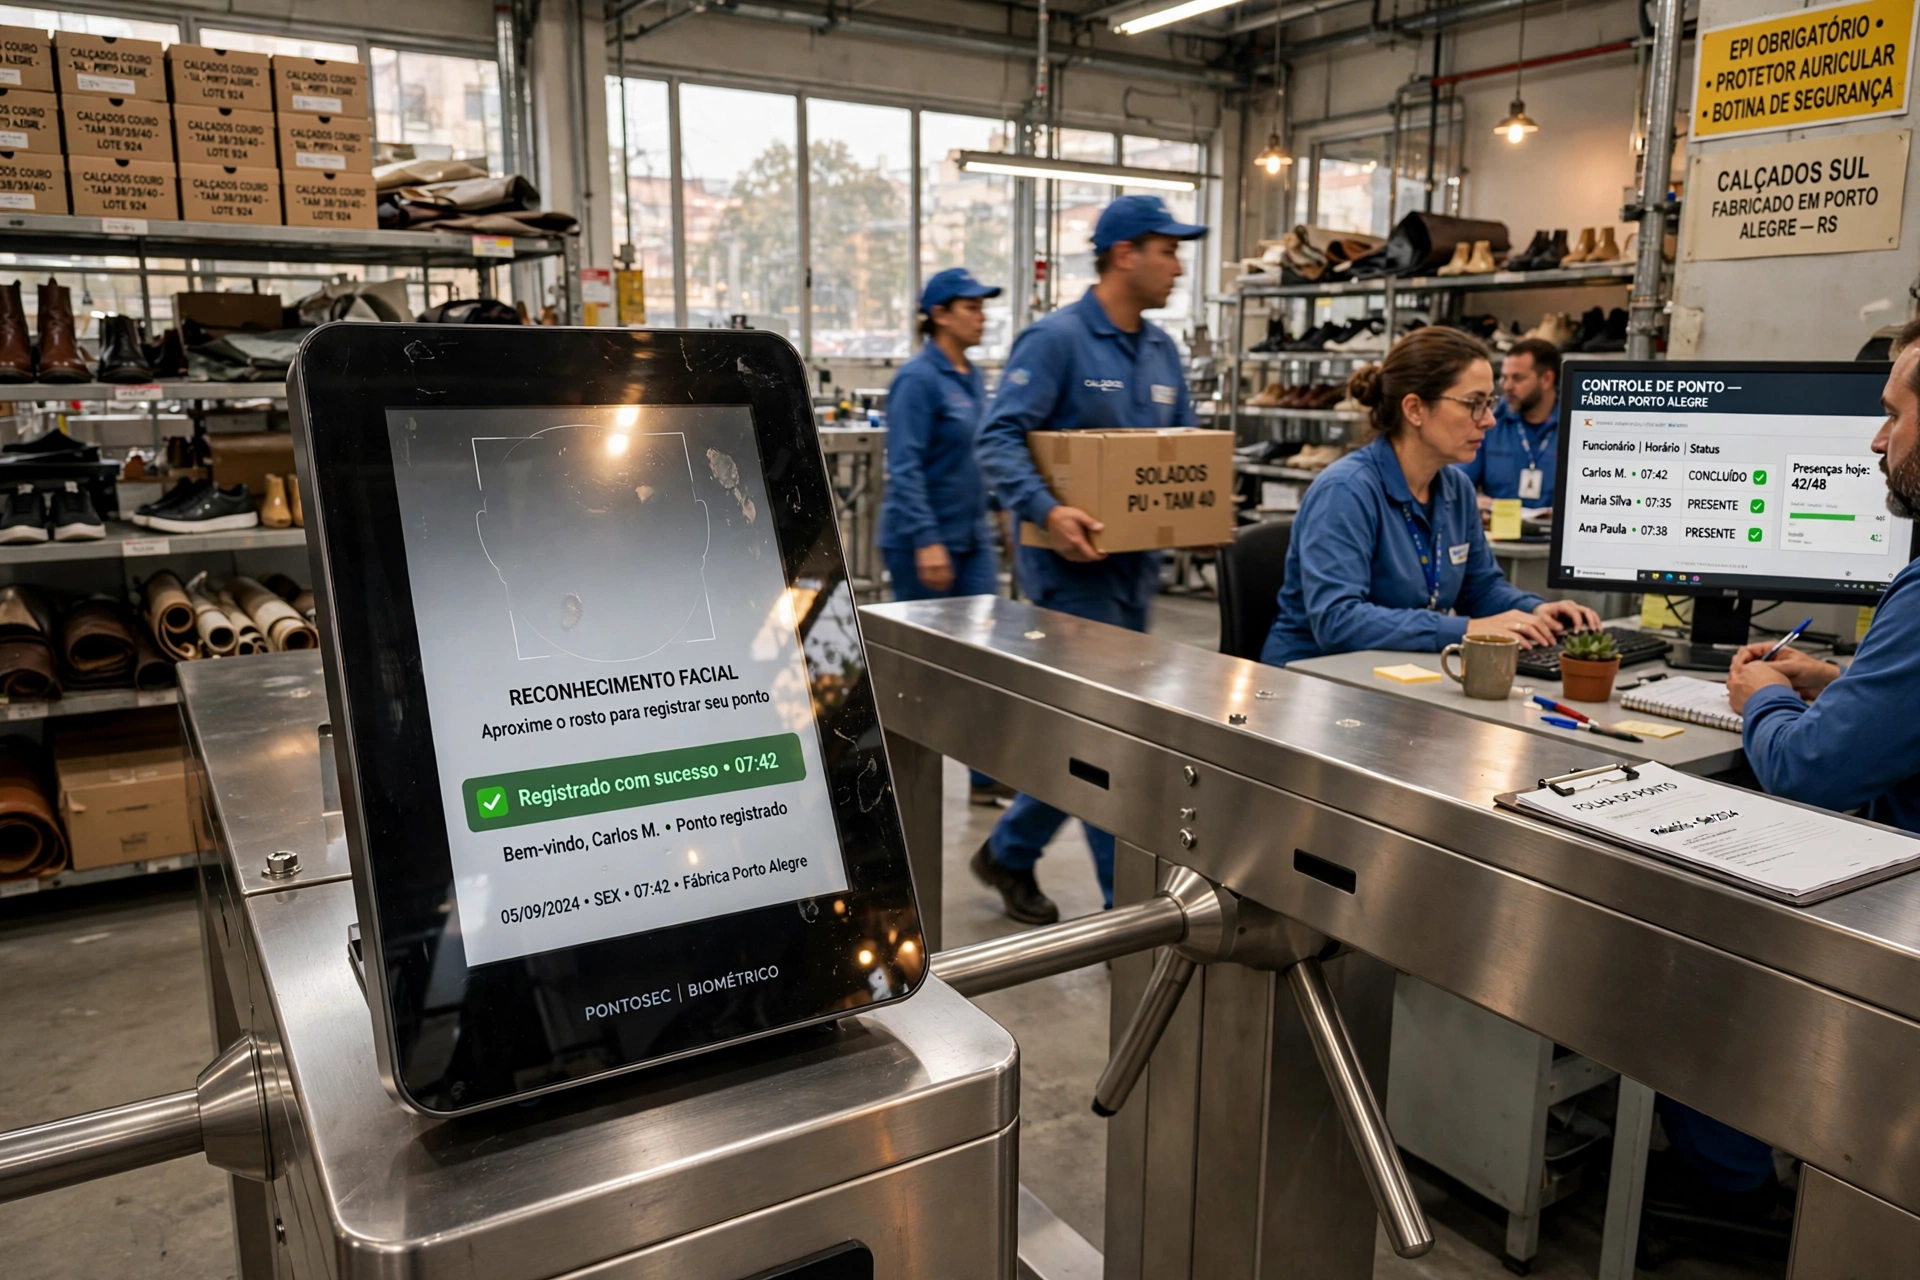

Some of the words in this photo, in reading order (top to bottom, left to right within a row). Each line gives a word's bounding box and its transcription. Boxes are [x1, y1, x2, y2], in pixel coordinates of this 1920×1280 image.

[1729, 37, 1753, 61] EPI
[1757, 15, 1870, 56] OBRIGATÓRIO
[4, 41, 38, 54] COURO
[70, 48, 118, 62] CALÇADOS
[121, 51, 152, 65] COURO
[184, 60, 229, 73] CALÇADOS
[231, 64, 259, 76] COURO
[1715, 60, 1796, 93] PROTETOR
[1799, 44, 1895, 80] AURICULAR
[286, 70, 328, 83] CALÇADOS
[330, 74, 357, 86] COURO
[202, 88, 225, 99] LOTE
[227, 89, 244, 100] 924
[1712, 95, 1765, 123] BOTINA
[1770, 92, 1789, 114] DE
[1793, 76, 1894, 112] SEGURANÇA
[12, 106, 45, 118] COURO
[77, 111, 126, 124] CALÇADOS
[128, 114, 158, 127] COURO
[84, 124, 106, 134] TAM
[188, 120, 233, 134] CALÇADOS
[235, 124, 264, 136] COURO
[291, 128, 332, 141] CALÇADOS
[334, 131, 361, 143] COURO
[98, 139, 122, 151] LOTE
[124, 141, 142, 152] 924
[196, 134, 215, 144] TAM
[206, 147, 229, 158] LOTE
[232, 148, 248, 160] 924
[20, 168, 52, 180] COURO
[83, 172, 132, 185] CALÇADOS
[134, 174, 164, 186] COURO
[1717, 161, 1822, 194] CALÇADOS
[1829, 156, 1870, 182] SUL
[90, 185, 112, 195] TAM
[193, 178, 238, 192] CALÇADOS
[240, 182, 269, 193] COURO
[296, 184, 337, 198] CALÇADOS
[339, 187, 366, 198] COURO
[200, 192, 220, 202] TAM
[302, 197, 321, 207] TAM
[1712, 194, 1794, 218] FABRICADO
[1798, 192, 1820, 210] EM
[1824, 186, 1879, 209] PORTO
[103, 200, 126, 210] LOTE
[130, 201, 147, 211] 924
[212, 206, 234, 216] LOTE
[237, 206, 252, 216] 924
[312, 211, 334, 221] LOTE
[336, 212, 352, 222] 924
[1739, 218, 1797, 240] ALEGRE
[1817, 215, 1838, 234] RS
[1582, 379, 1653, 392] CONTROLE
[1656, 380, 1674, 393] DE
[1677, 381, 1724, 393] PONTO
[1581, 392, 1626, 406] FÁBRICA
[1628, 396, 1665, 407] PORTO
[1667, 396, 1708, 408] ALEGRE
[1582, 440, 1636, 452] Funcionário
[1644, 441, 1680, 453] Horário
[1690, 444, 1720, 454] Status
[1135, 464, 1208, 486] SOLADOS
[1582, 466, 1612, 479] Carlos
[1614, 468, 1627, 479] M.
[1640, 469, 1668, 480] 07:42
[1688, 467, 1748, 483] CONCLUÍDO
[1792, 463, 1842, 476] Presenças
[1845, 464, 1870, 478] hoje:
[1791, 478, 1827, 490] 42/48
[1127, 494, 1149, 512] PU
[1164, 491, 1195, 511] TAM
[1198, 490, 1216, 508] 40
[1580, 494, 1606, 507] Maria
[1608, 494, 1632, 508] Silva
[1645, 497, 1672, 508] 07:35
[1688, 498, 1738, 511] PRESENTE
[1578, 523, 1598, 534] Ana
[1600, 523, 1627, 536] Paula
[1640, 525, 1668, 537] 07:38
[1686, 526, 1736, 540] PRESENTE
[509, 671, 676, 706] RECONHECIMENTO
[678, 664, 740, 686] FACIAL
[481, 714, 553, 742] Aproxime
[556, 715, 566, 729] o
[569, 709, 606, 727] rosto
[609, 706, 641, 726] para
[643, 696, 701, 721] registrar
[704, 694, 729, 712] seu
[731, 688, 770, 711] ponto
[518, 777, 611, 808] Registrado
[614, 771, 651, 792] com
[654, 762, 719, 787] sucesso
[734, 751, 778, 774] 07:42
[1572, 798, 1616, 812] FOLHA
[1616, 792, 1635, 803] DE
[503, 834, 589, 862] Bem-vindo,
[592, 825, 639, 848] Carlos
[641, 823, 660, 840] M.
[676, 812, 718, 834] Ponto
[720, 800, 788, 826] registrado
[500, 896, 581, 926] 05/09/2024
[594, 888, 622, 907] SEX
[633, 879, 671, 899] 07:42
[682, 869, 730, 891] Fábrica
[732, 862, 767, 881] Porto
[768, 853, 808, 877] Alegre
[585, 988, 672, 1021] PONTOSEC
[688, 964, 780, 998] BIOMÉTRICO
